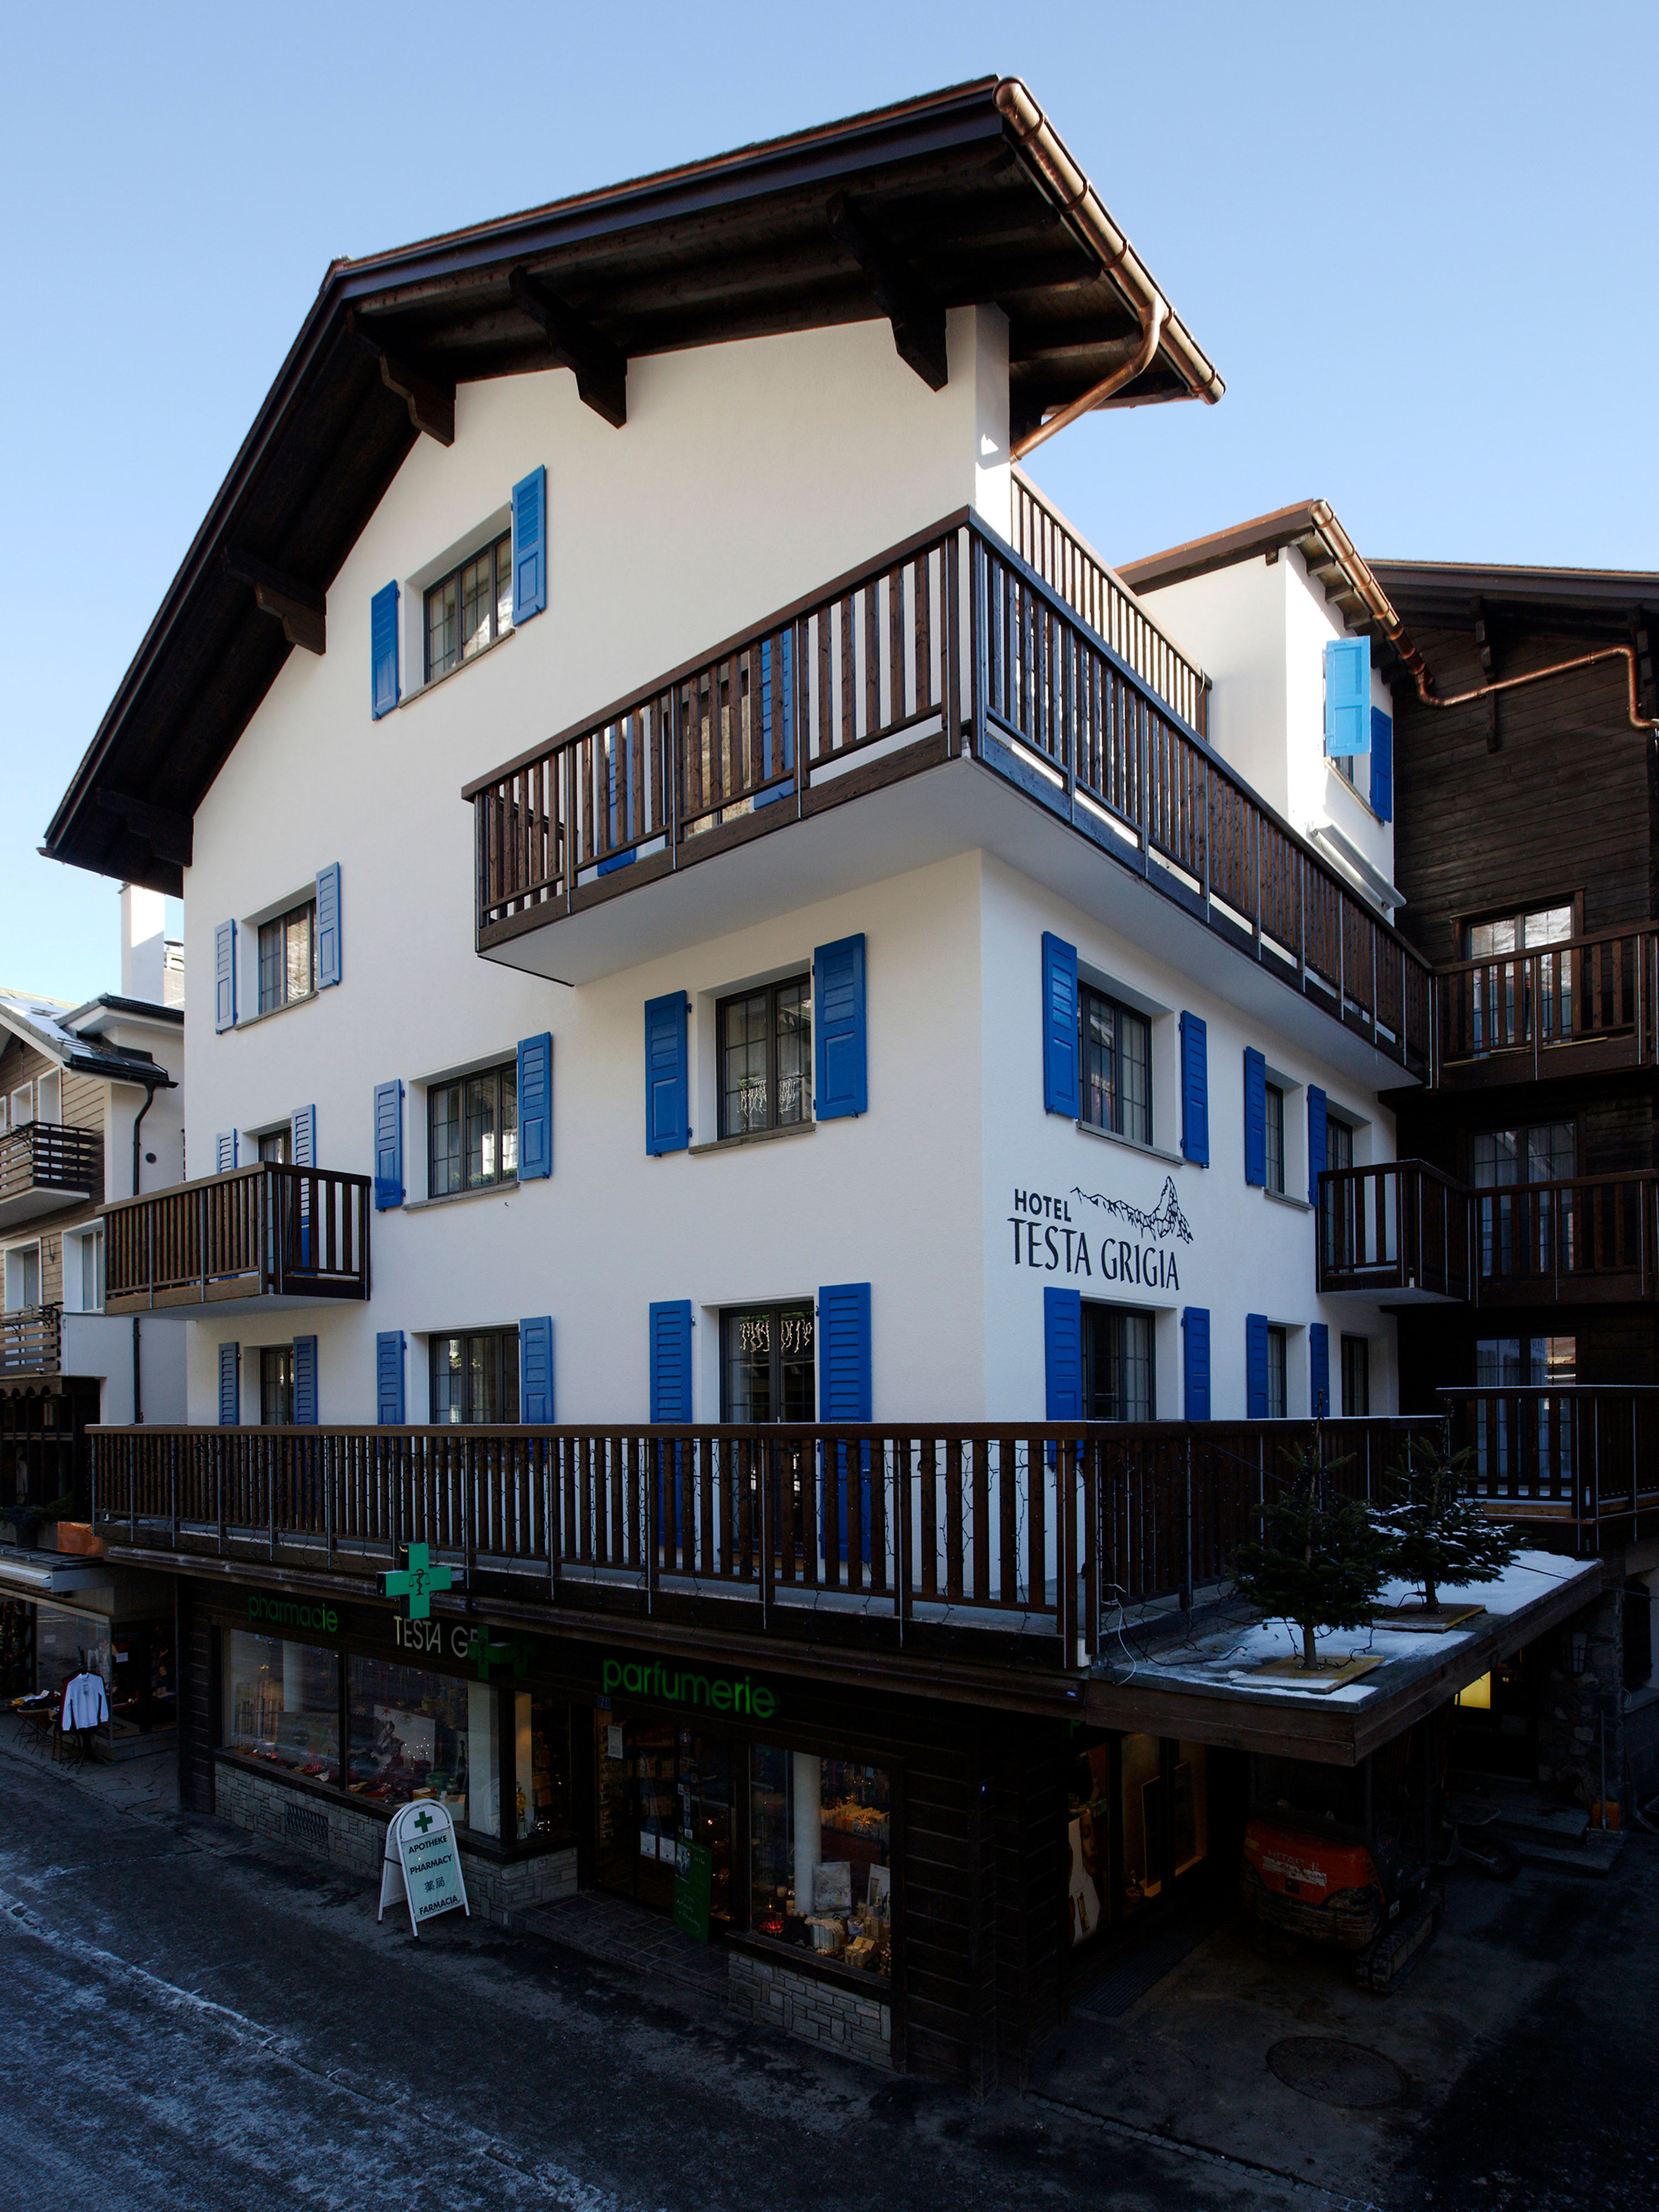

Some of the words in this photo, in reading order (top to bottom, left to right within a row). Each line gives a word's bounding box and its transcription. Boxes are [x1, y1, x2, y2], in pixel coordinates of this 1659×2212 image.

[1014, 1188, 1072, 1223] HOTEL
[1007, 1217, 1092, 1276] TESTA
[1101, 1238, 1180, 1291] GRIGIA
[248, 1590, 338, 1632] pharmacie
[393, 1615, 441, 1654] TESTA
[602, 1658, 777, 1718] parfumerie
[409, 1835, 448, 1854] APOTHEKE
[409, 1854, 452, 1875] PHARMACY
[424, 1876, 445, 1893] 薬局
[419, 1895, 458, 1915] FARMACIA
